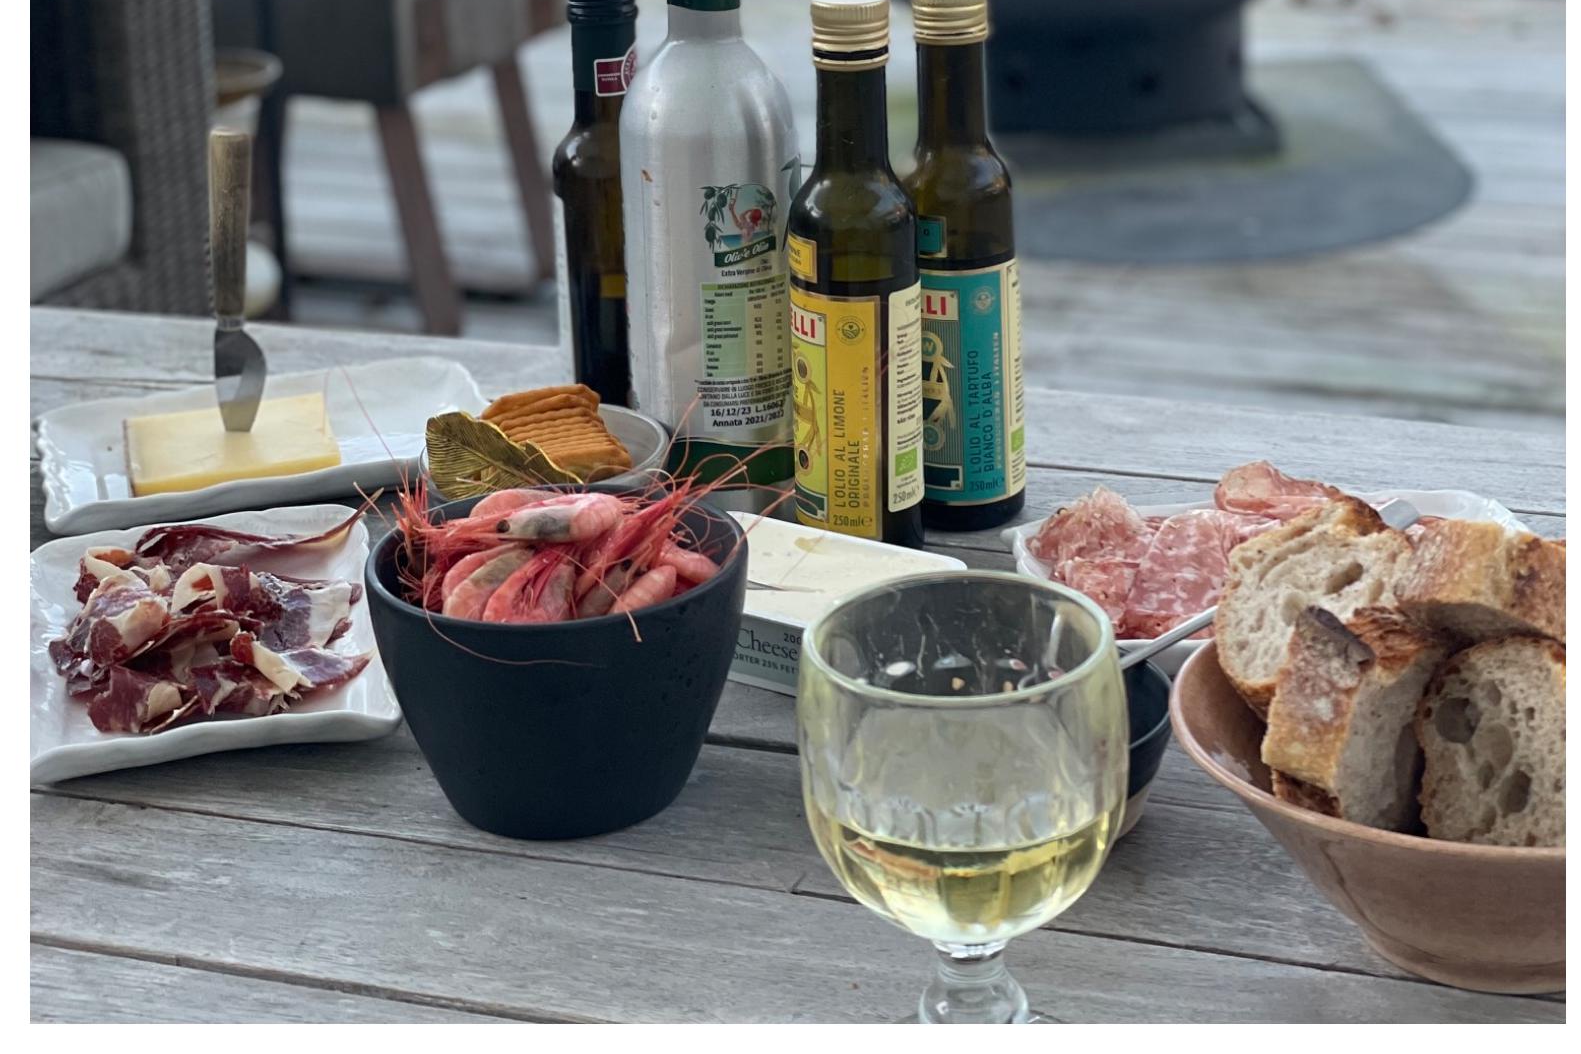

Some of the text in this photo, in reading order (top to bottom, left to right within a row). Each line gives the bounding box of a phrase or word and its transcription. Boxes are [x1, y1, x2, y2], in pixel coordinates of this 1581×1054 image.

[921, 295, 946, 316] LI
[967, 350, 980, 407] TARTUFO
[711, 406, 752, 417] 16/12/23
[713, 419, 743, 427] Annata
[833, 389, 845, 438] LIMONE
[969, 410, 980, 429] AL
[834, 445, 846, 461] AL
[982, 425, 994, 472] BIANCO
[848, 440, 860, 509] ORIGINALE
[736, 628, 799, 662] Cheese
